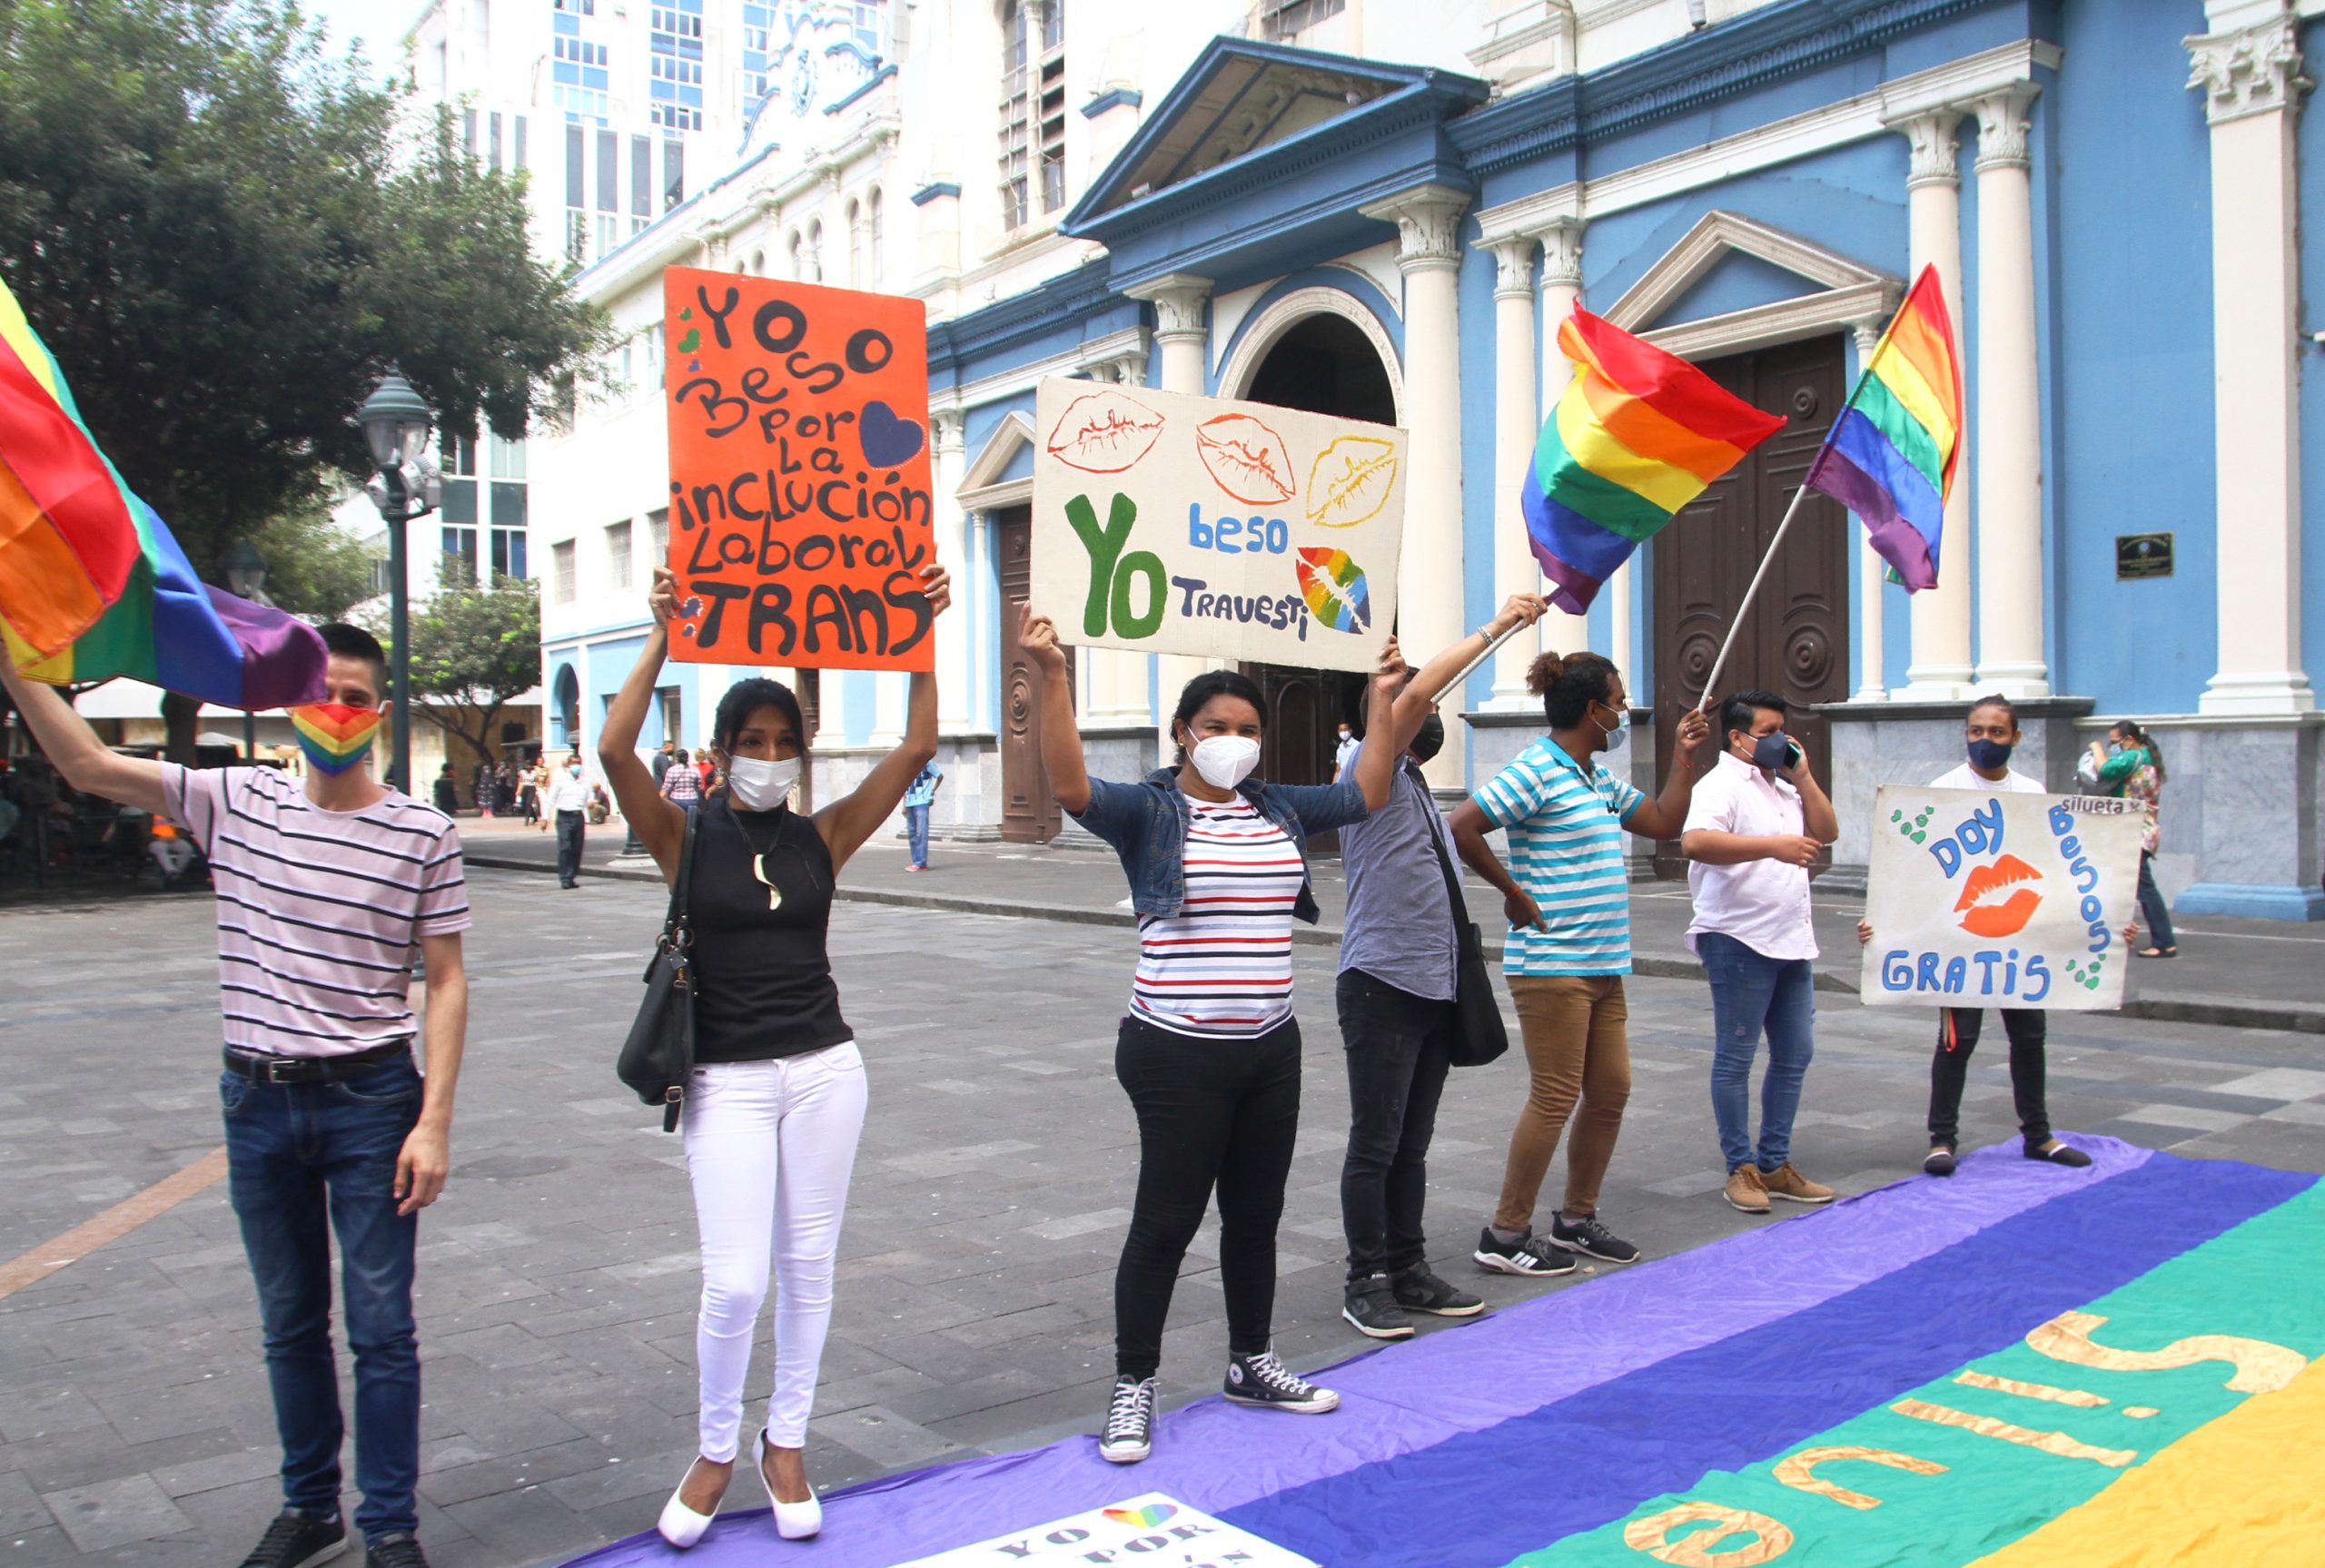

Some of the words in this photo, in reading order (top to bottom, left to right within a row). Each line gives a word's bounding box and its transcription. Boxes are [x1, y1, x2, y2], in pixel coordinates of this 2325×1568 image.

[698, 285, 807, 353] YO
[1189, 502, 1289, 554] beso
[2062, 796, 2124, 814] silueta
[987, 1528, 1091, 1560] YO
[1077, 1524, 1220, 1564] POR
